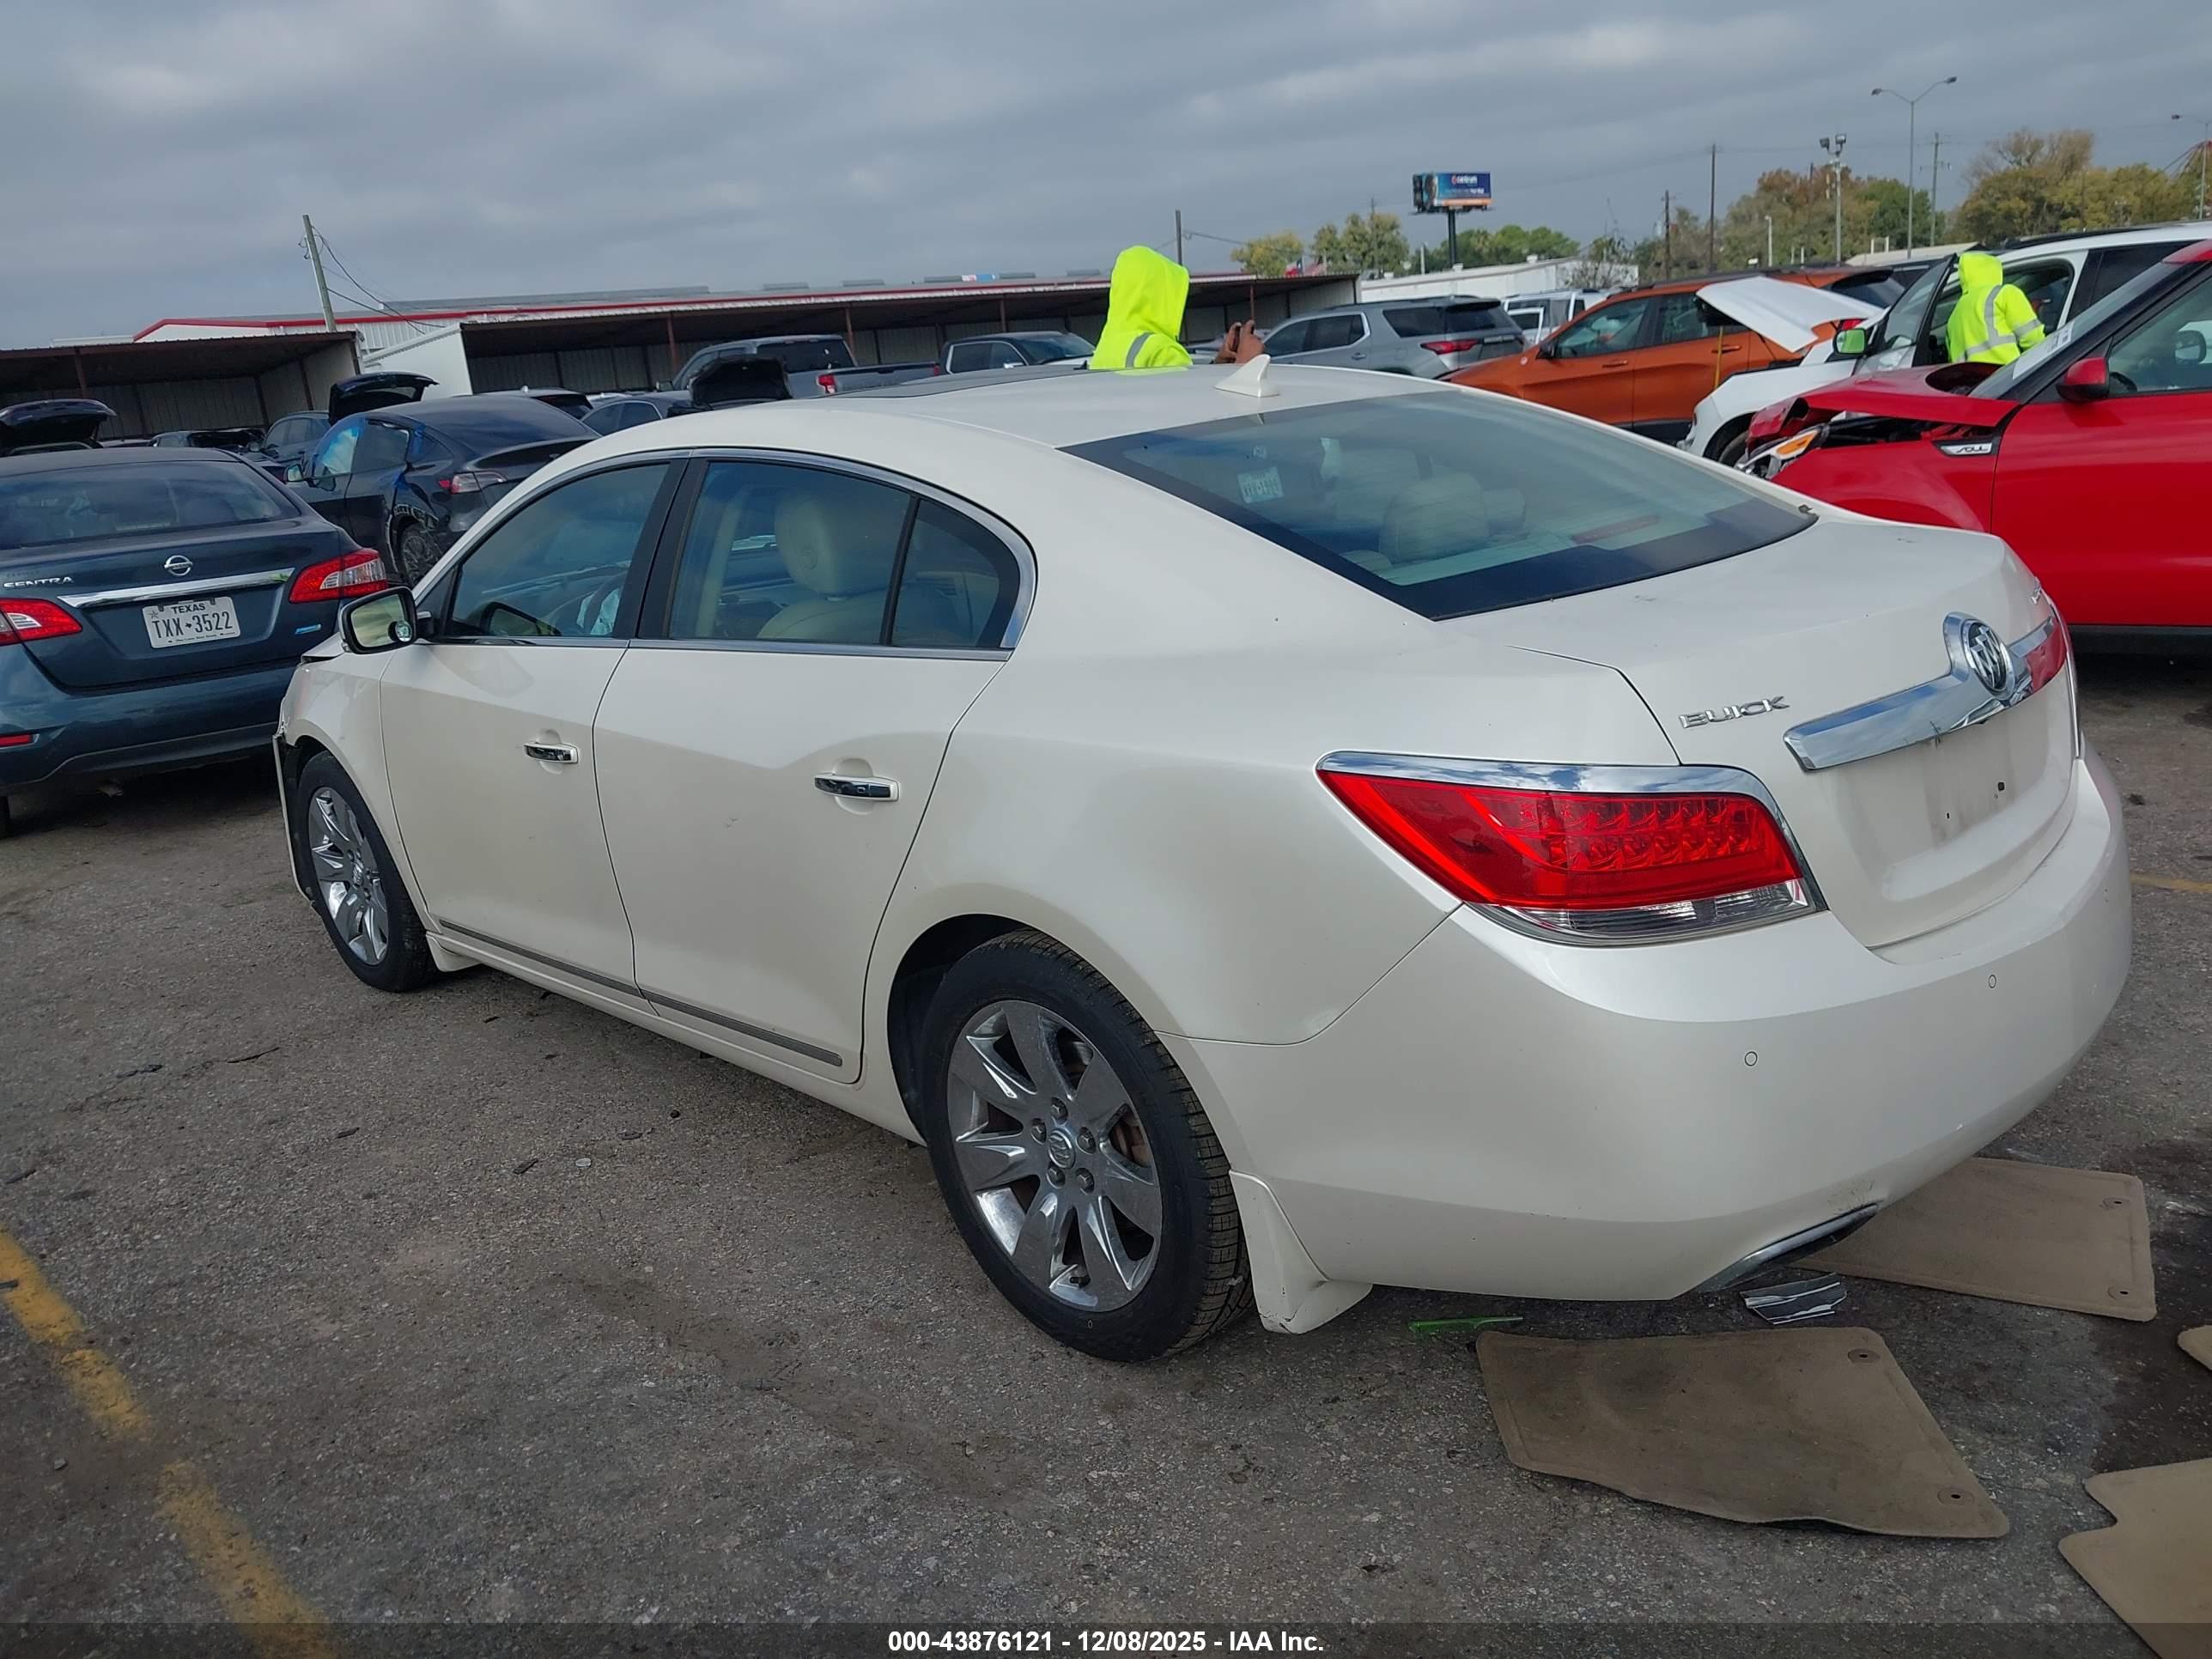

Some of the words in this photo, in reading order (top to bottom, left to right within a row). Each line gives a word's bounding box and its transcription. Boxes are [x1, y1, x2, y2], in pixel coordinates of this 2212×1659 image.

[3, 576, 74, 588] SENTRA
[171, 603, 206, 614] TEXAS
[1679, 696, 1790, 728] BUICK
